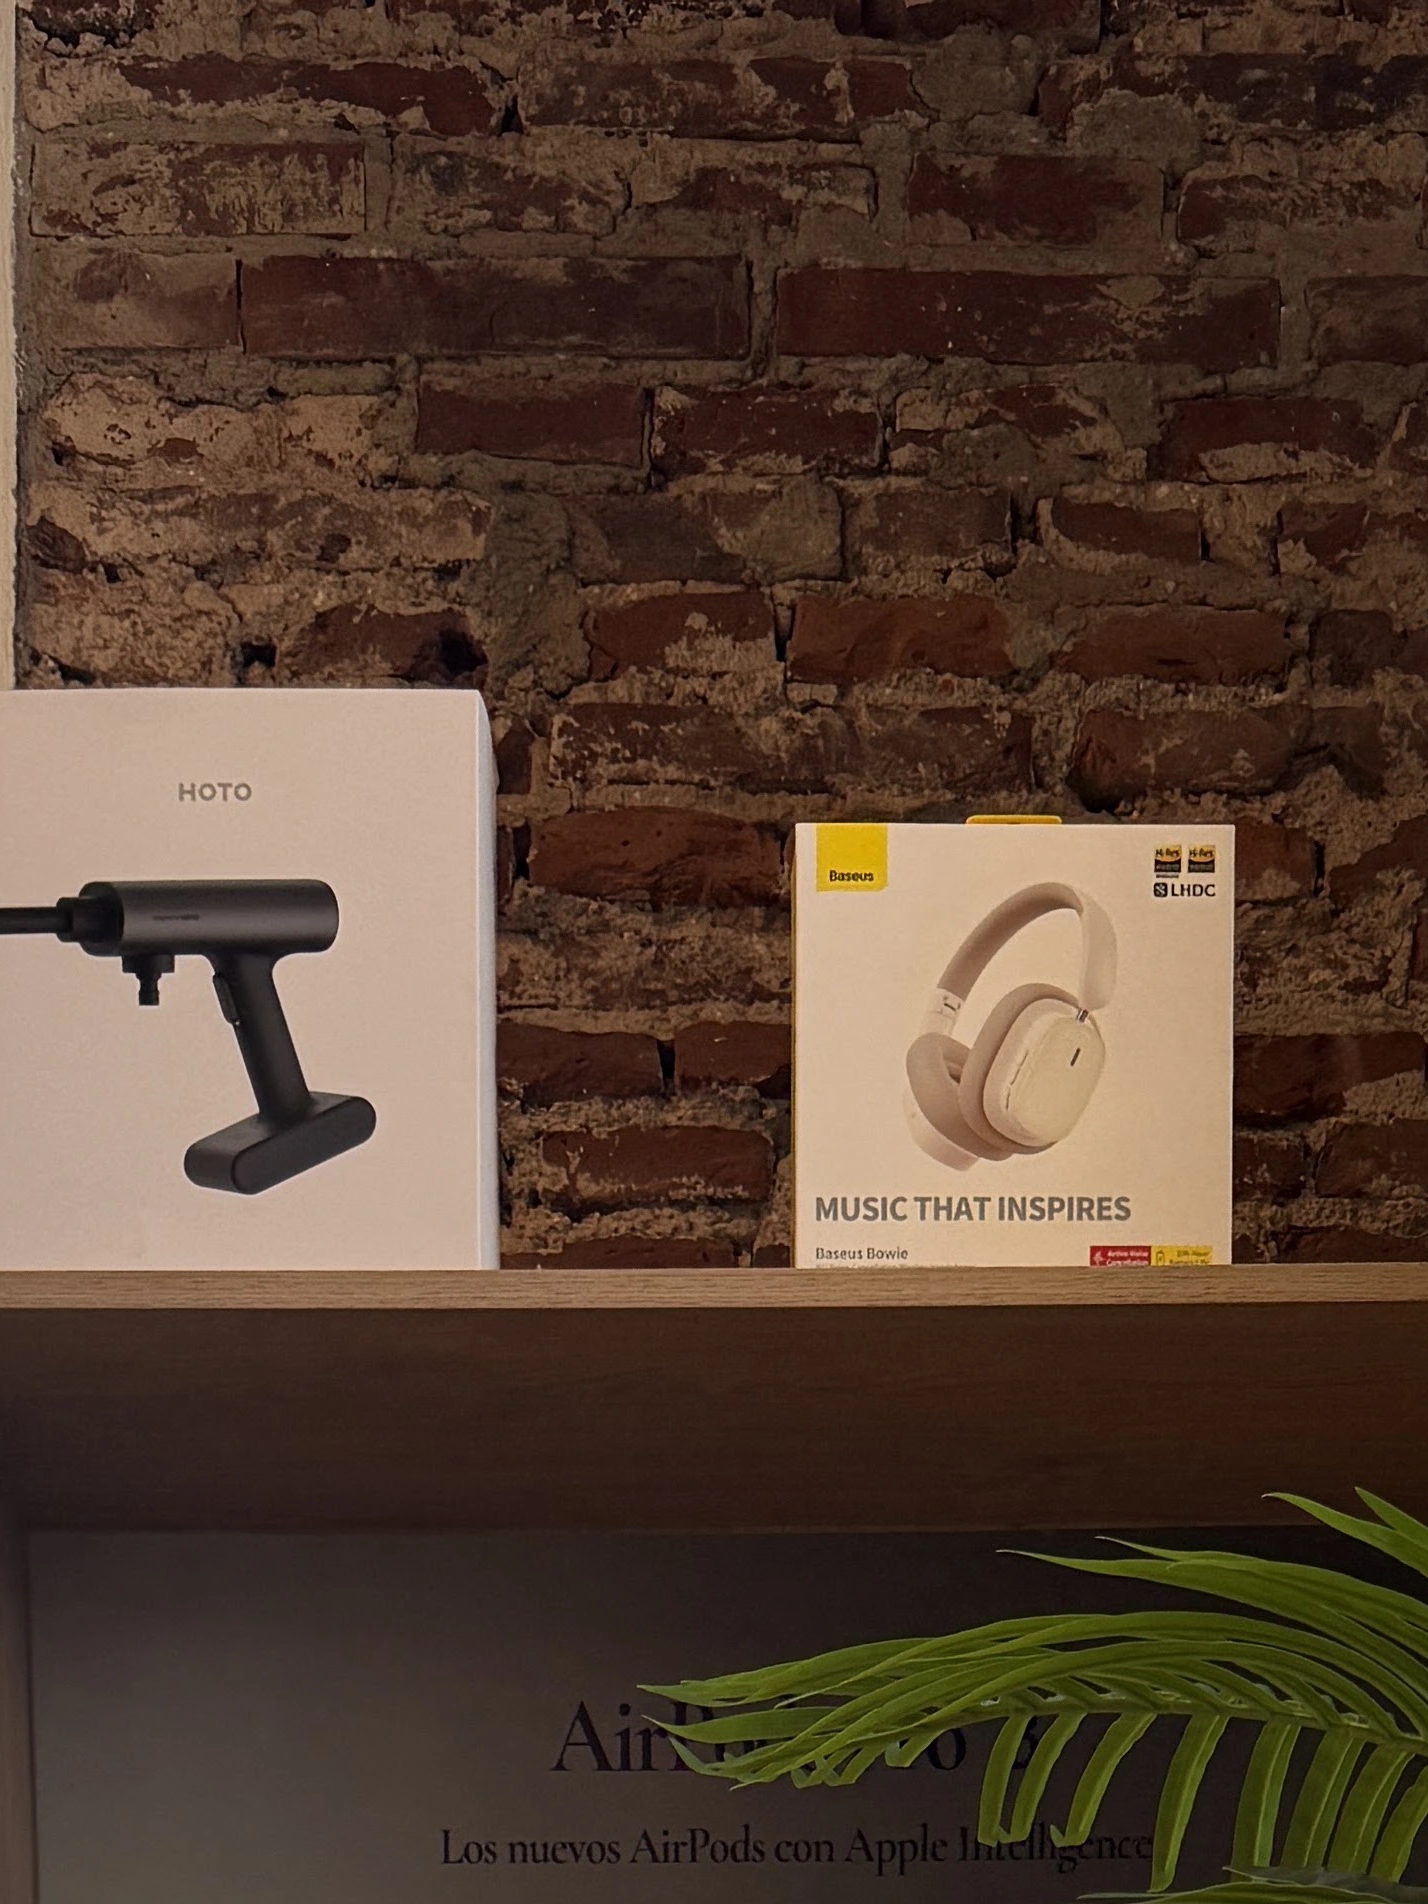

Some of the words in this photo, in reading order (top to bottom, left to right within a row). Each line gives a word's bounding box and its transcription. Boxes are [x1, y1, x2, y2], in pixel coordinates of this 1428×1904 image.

[178, 783, 252, 802] HOTO
[829, 870, 874, 882] Baseus
[1171, 884, 1216, 897] LHDC
[815, 1196, 908, 1222] MUSIC
[914, 1196, 991, 1221] THAT
[998, 1196, 1131, 1222] INSPIRES
[816, 1248, 863, 1260] Baseus
[867, 1247, 908, 1260] Bowie
[441, 1829, 497, 1866] Los
[508, 1836, 621, 1866] nuevos
[629, 1826, 765, 1866] AirPods
[775, 1839, 835, 1866] con
[844, 1824, 948, 1876] Apple
